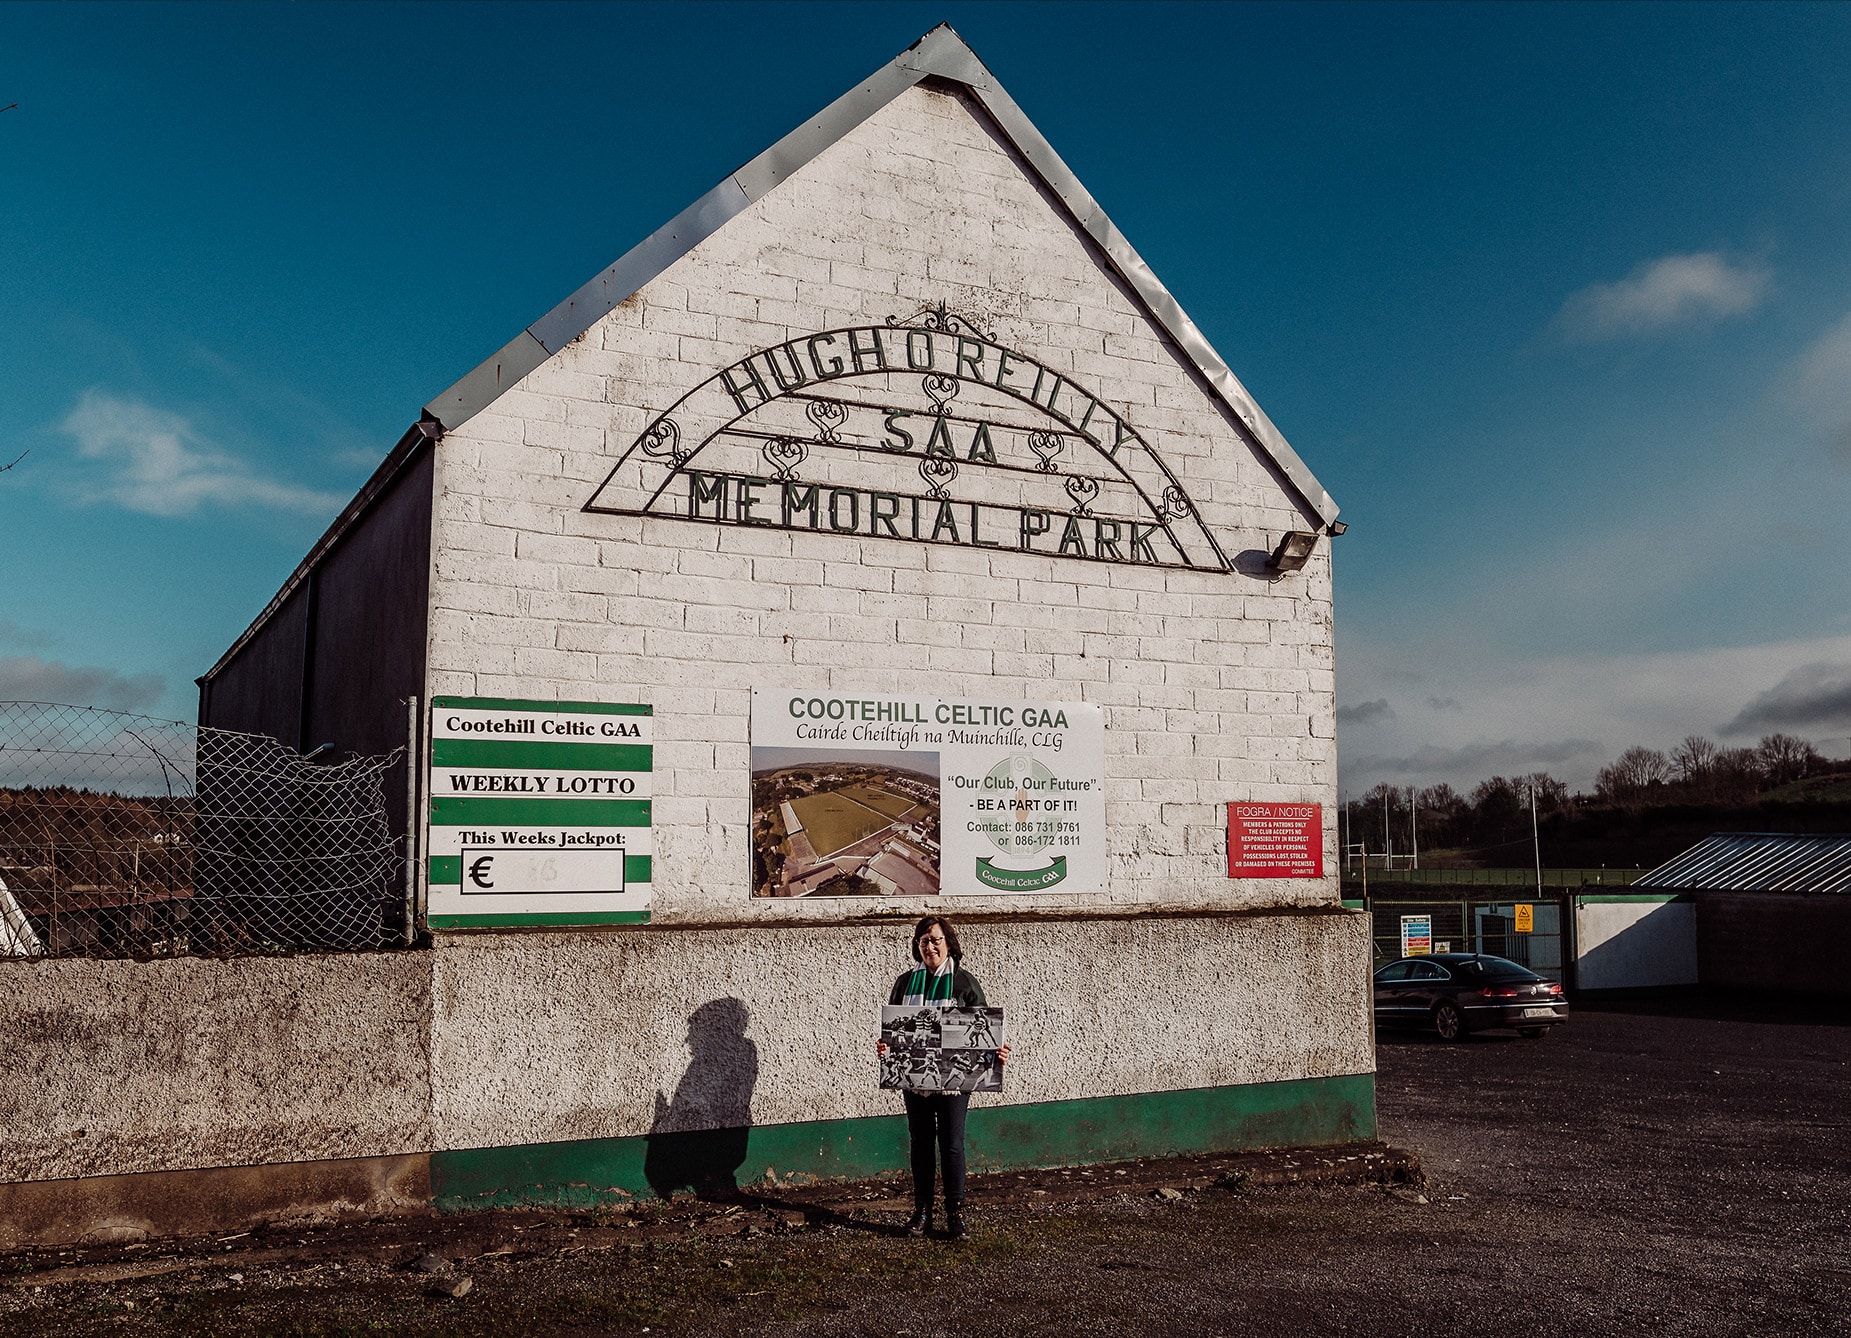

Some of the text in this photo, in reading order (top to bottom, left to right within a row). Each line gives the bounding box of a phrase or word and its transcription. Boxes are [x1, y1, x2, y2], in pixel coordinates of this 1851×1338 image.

[719, 328, 888, 416] HUGH
[880, 409, 998, 465] SAA
[688, 470, 1159, 563] MEMORIAL PARK
[788, 697, 1069, 729] COOTEHILL CELTIC GAA
[446, 716, 641, 737] Cootehill Celtic GAA
[796, 721, 1063, 753] Cairde Cheiltigh na Muinchille, CLG
[449, 774, 636, 794] WEEKLY LOTTO
[984, 776, 1018, 791] Club,
[1022, 777, 1046, 790] Our
[977, 799, 994, 811] BE
[997, 799, 1006, 811] A
[1009, 799, 1041, 811] PART
[1044, 800, 1060, 811] OF
[1063, 800, 1077, 812] IT!
[1236, 806, 1271, 817] FOGRA
[1279, 807, 1313, 817] NOTICE
[966, 821, 1080, 833] Contact: 086 731 9761
[458, 831, 626, 847] This Weeks Jackpot:
[998, 835, 1080, 846] or 086-172 1811
